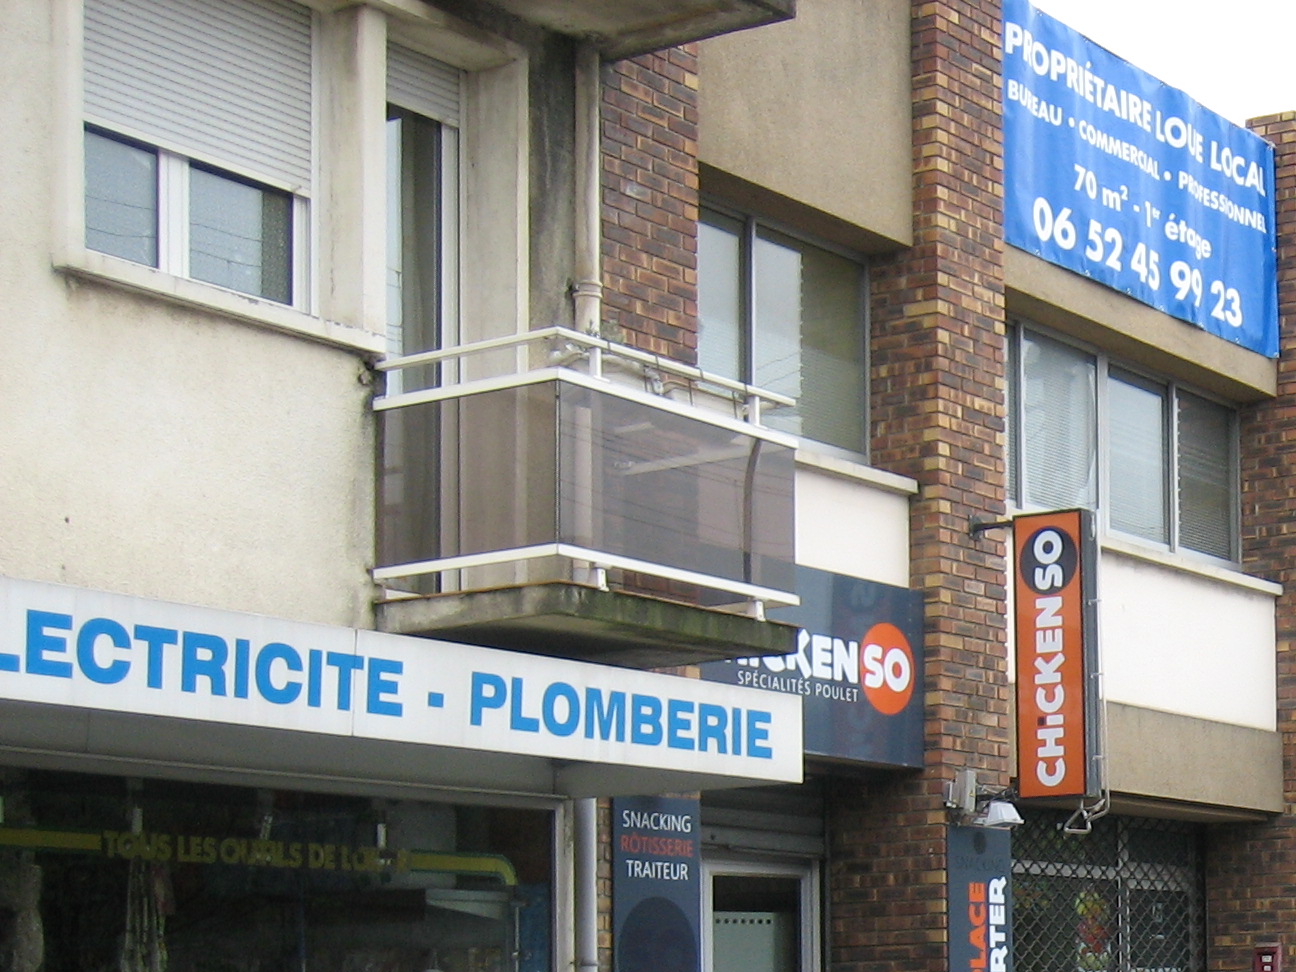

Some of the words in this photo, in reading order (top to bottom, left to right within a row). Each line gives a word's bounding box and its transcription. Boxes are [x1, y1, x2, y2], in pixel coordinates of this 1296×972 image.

[1005, 22, 1151, 133] PROPRIÉTAIRE
[1156, 111, 1203, 163] LOUE
[1210, 140, 1266, 197] LOCAL
[1008, 79, 1062, 126] BUREAU
[1079, 120, 1160, 180] COMMERCIAL
[1178, 171, 1267, 234] PROFESSIONNEL
[1074, 164, 1097, 200] 70
[1165, 214, 1212, 259] étage
[1033, 197, 1077, 250] 06
[1085, 220, 1122, 272] 52
[1131, 242, 1160, 291] 45
[1170, 261, 1203, 308] 99
[1210, 280, 1243, 327] 23
[470, 671, 773, 760] PLOMBERIE
[737, 670, 811, 696] SPÉCIALITÉS
[816, 683, 859, 702] POULET
[622, 810, 691, 833] SNACKING
[626, 860, 689, 881] TRAITEUR
